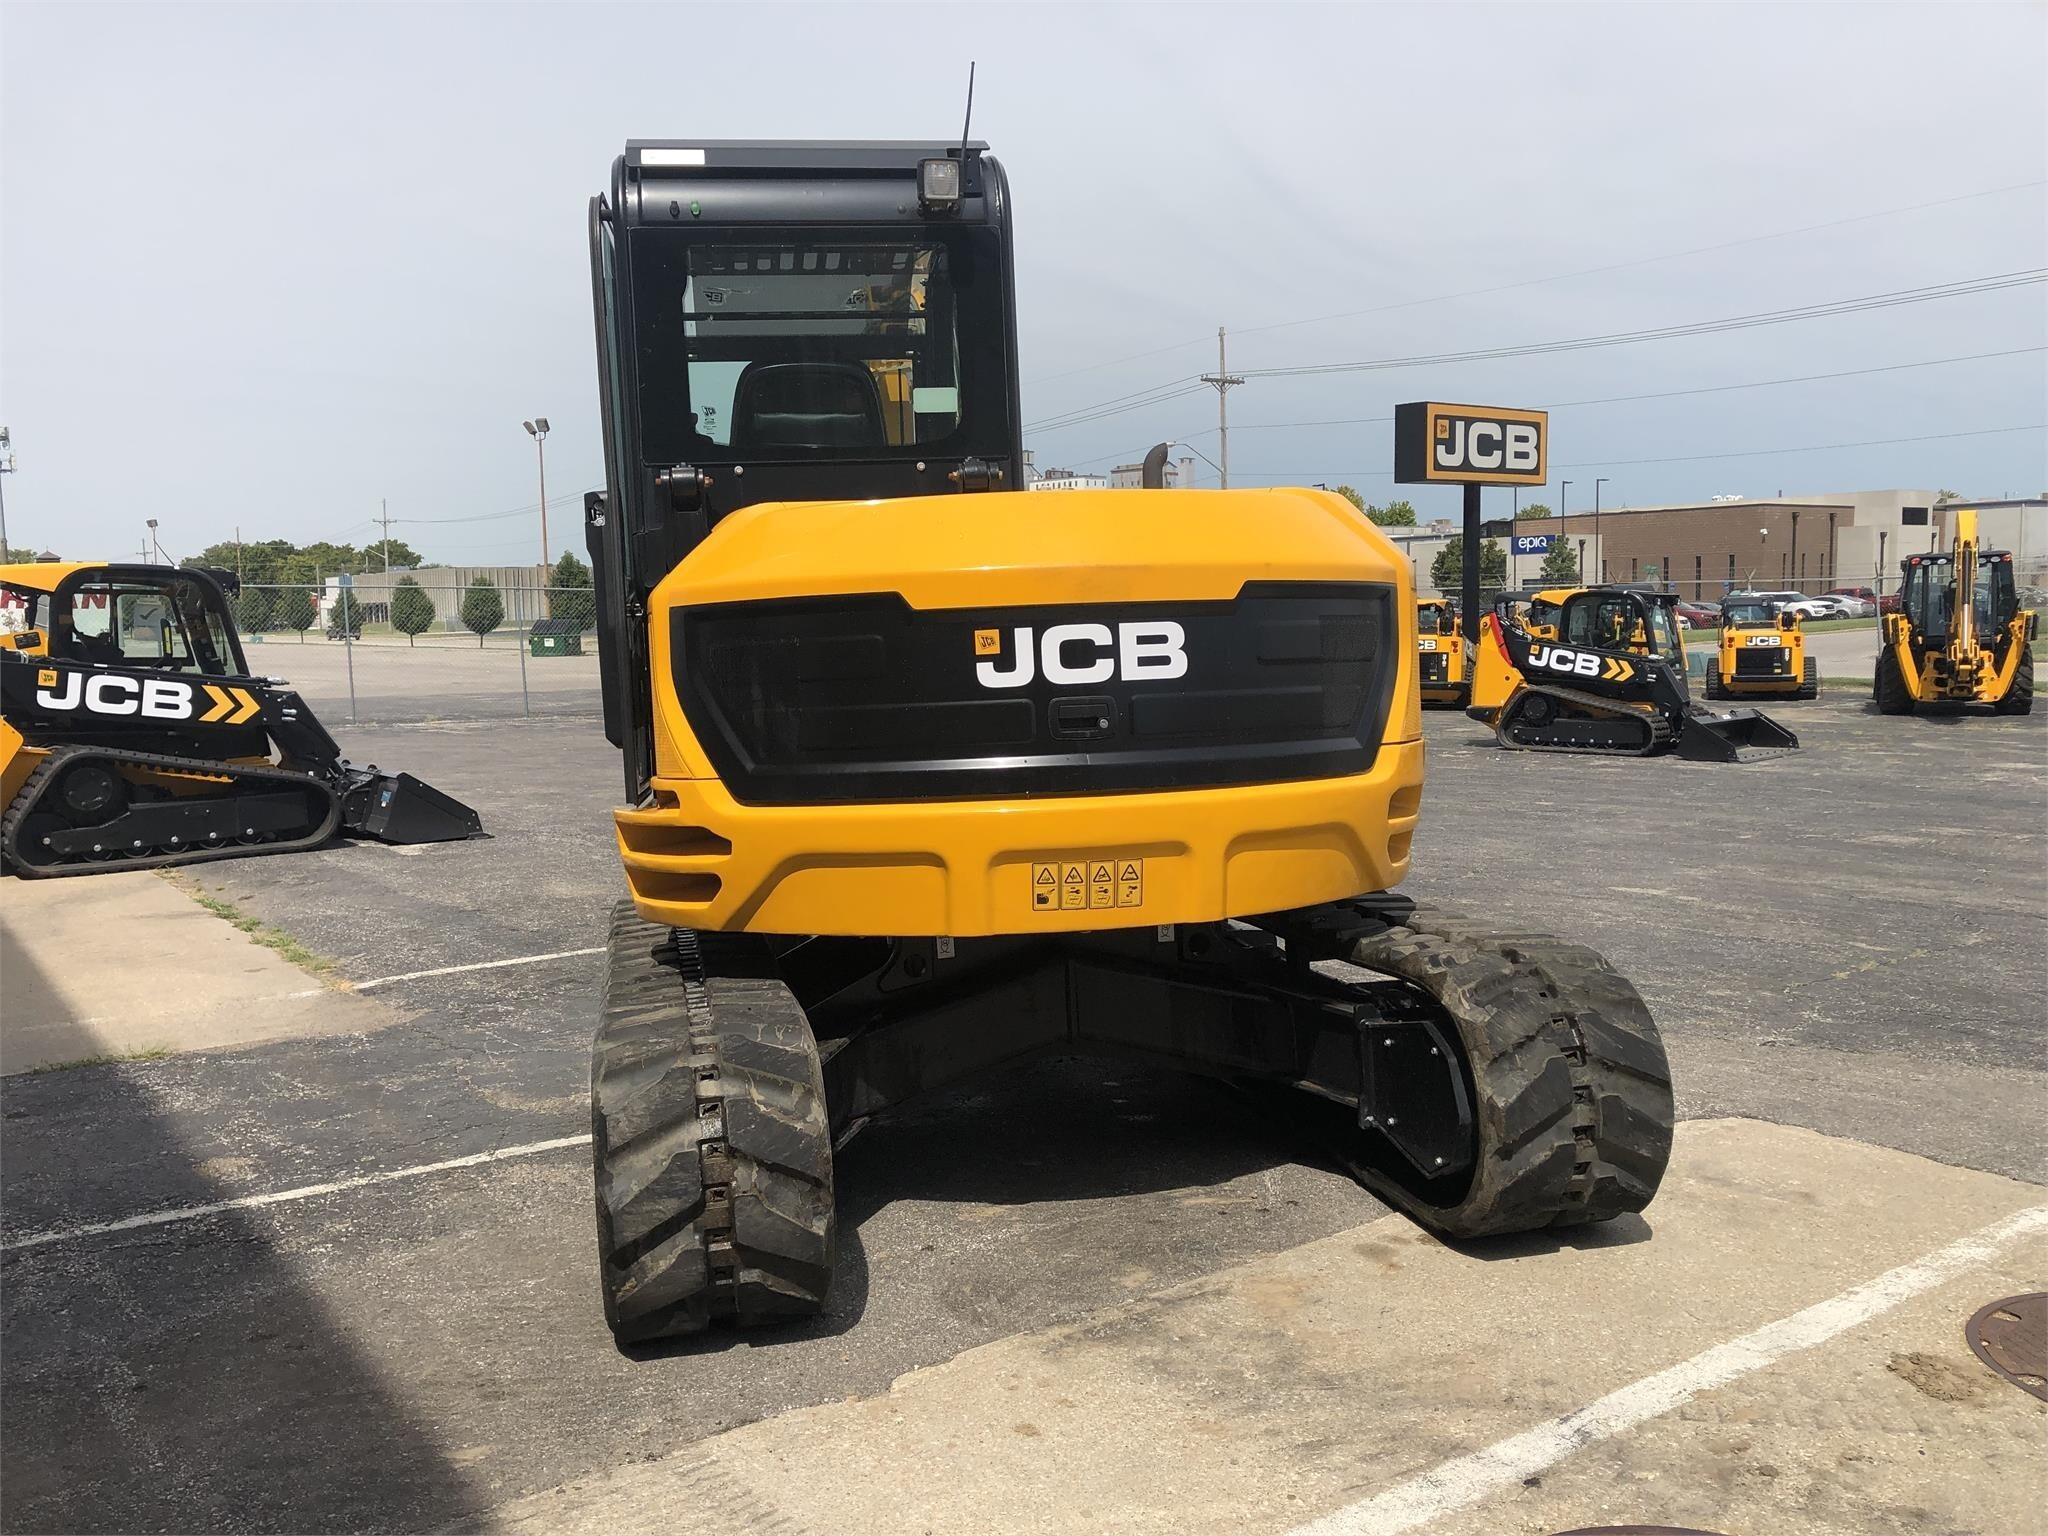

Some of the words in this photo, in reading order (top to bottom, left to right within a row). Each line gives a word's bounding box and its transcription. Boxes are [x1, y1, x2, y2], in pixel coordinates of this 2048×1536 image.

[1436, 420, 1538, 470] JCB
[976, 621, 1188, 688] JCB
[1528, 647, 1600, 677] JCB
[1746, 636, 1781, 646] JCB
[36, 672, 192, 719] JCB
